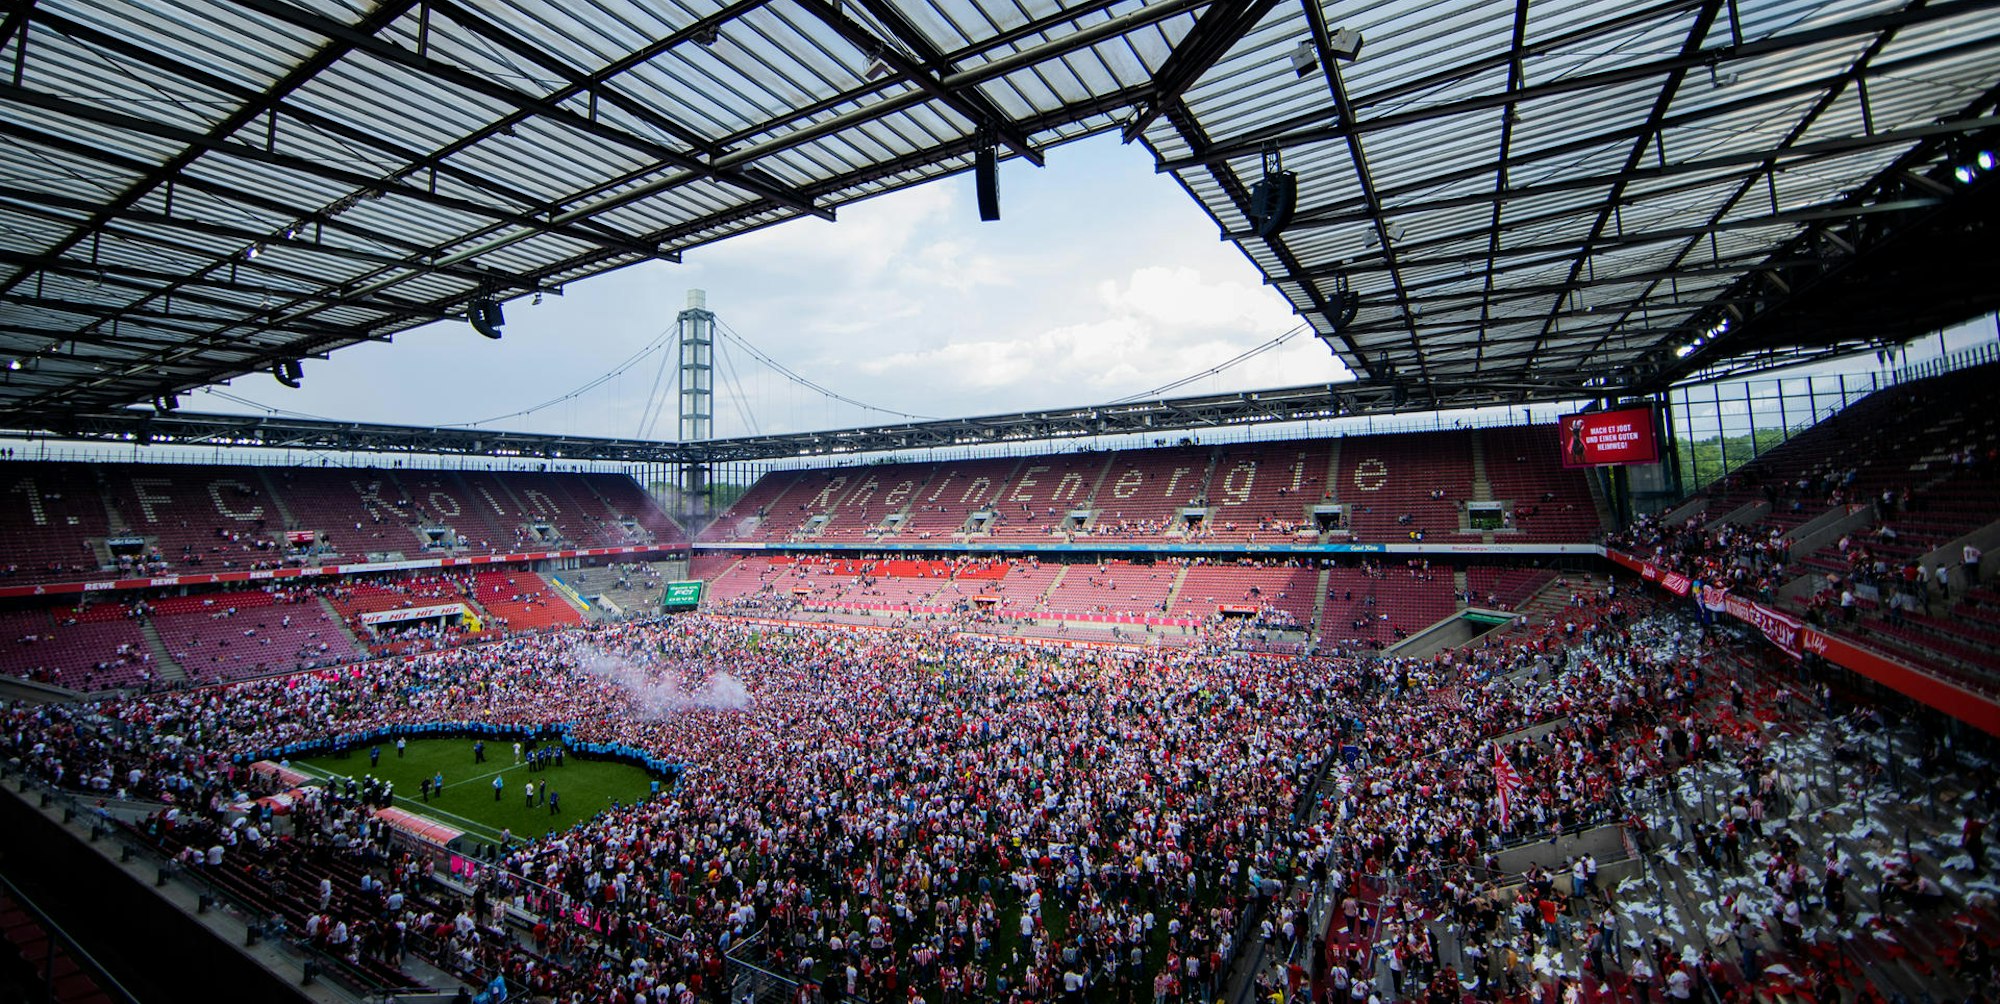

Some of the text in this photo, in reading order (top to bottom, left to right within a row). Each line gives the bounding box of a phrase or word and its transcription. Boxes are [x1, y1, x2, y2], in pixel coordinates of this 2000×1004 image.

[1590, 427, 1607, 435] MACH
[1586, 432, 1638, 444] UND EINEN GUTEN
[133, 478, 264, 523] FC
[351, 480, 561, 519] Köln
[250, 570, 274, 579] REWE
[301, 567, 323, 576] REWE
[84, 582, 115, 591] REWE
[150, 578, 179, 587] REWE
[363, 607, 459, 623] HIT HIT HIT HIT
